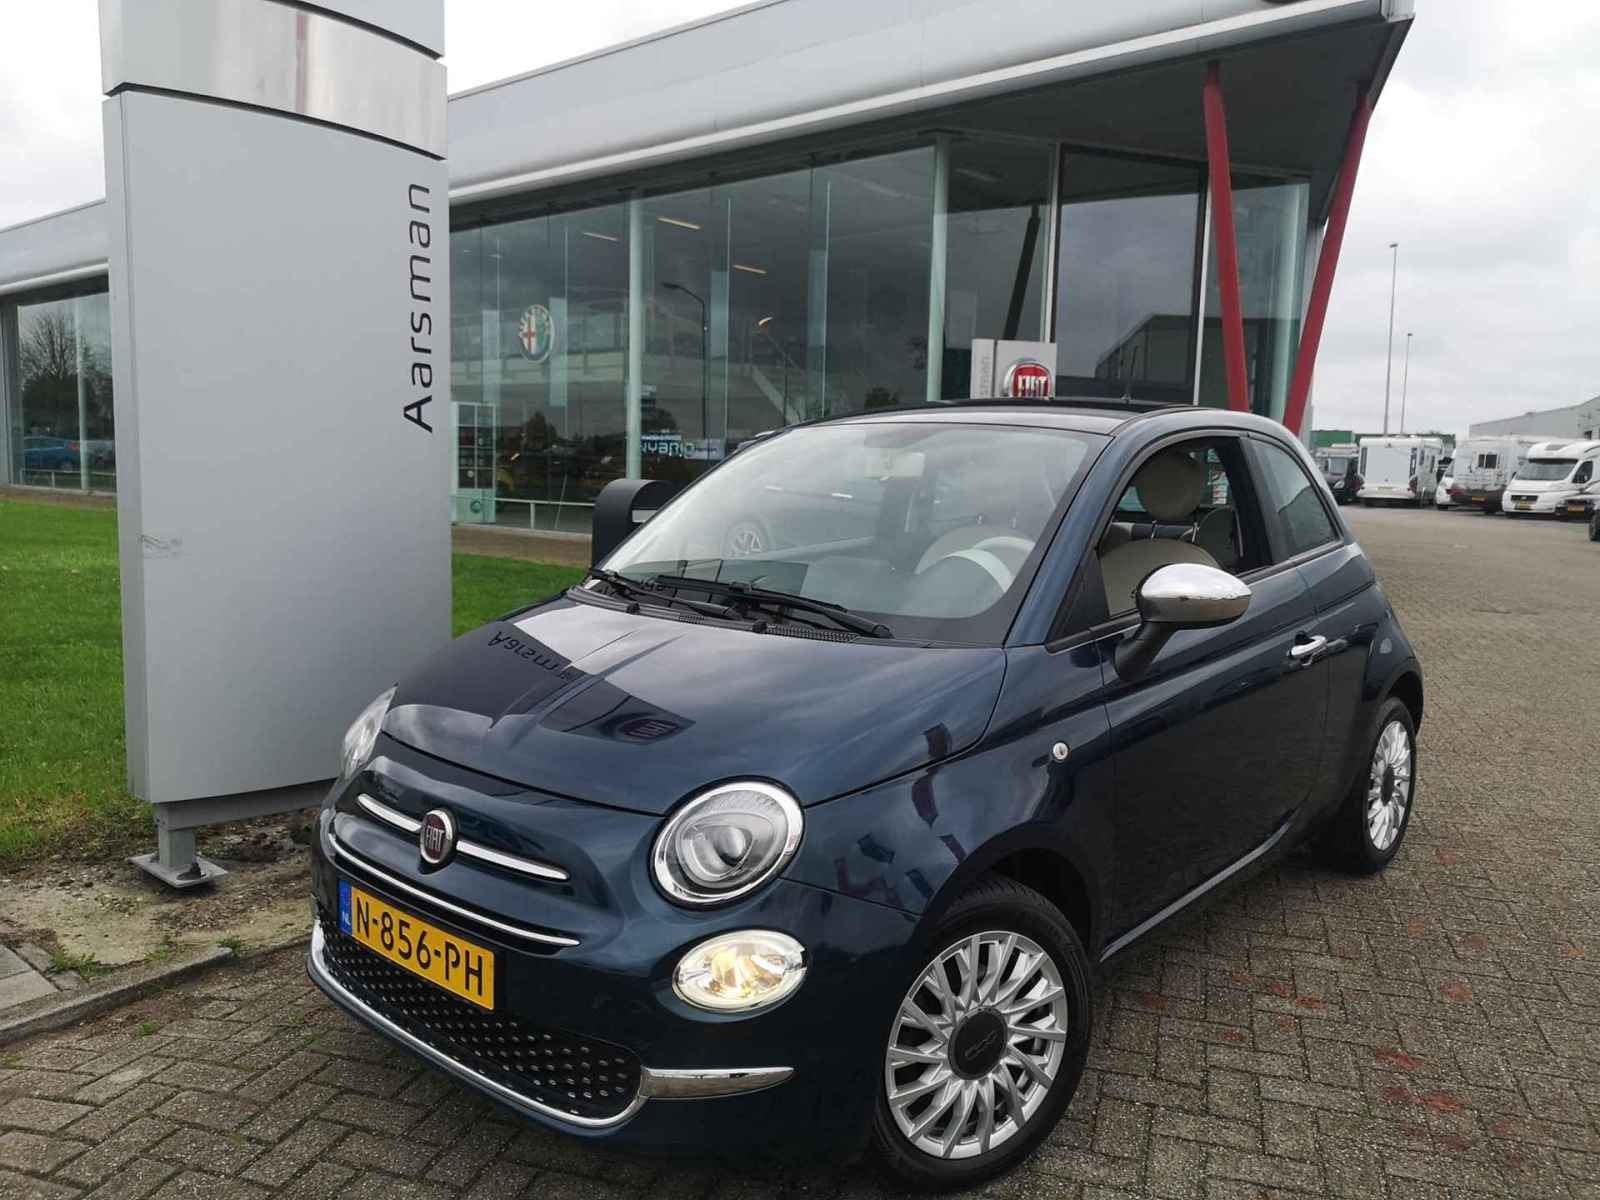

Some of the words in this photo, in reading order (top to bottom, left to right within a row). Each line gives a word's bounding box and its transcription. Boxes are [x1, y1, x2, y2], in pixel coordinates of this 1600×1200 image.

[403, 184, 433, 433] Aarsman
[425, 825, 445, 851] FIAT
[356, 896, 483, 997] N-856-PH
